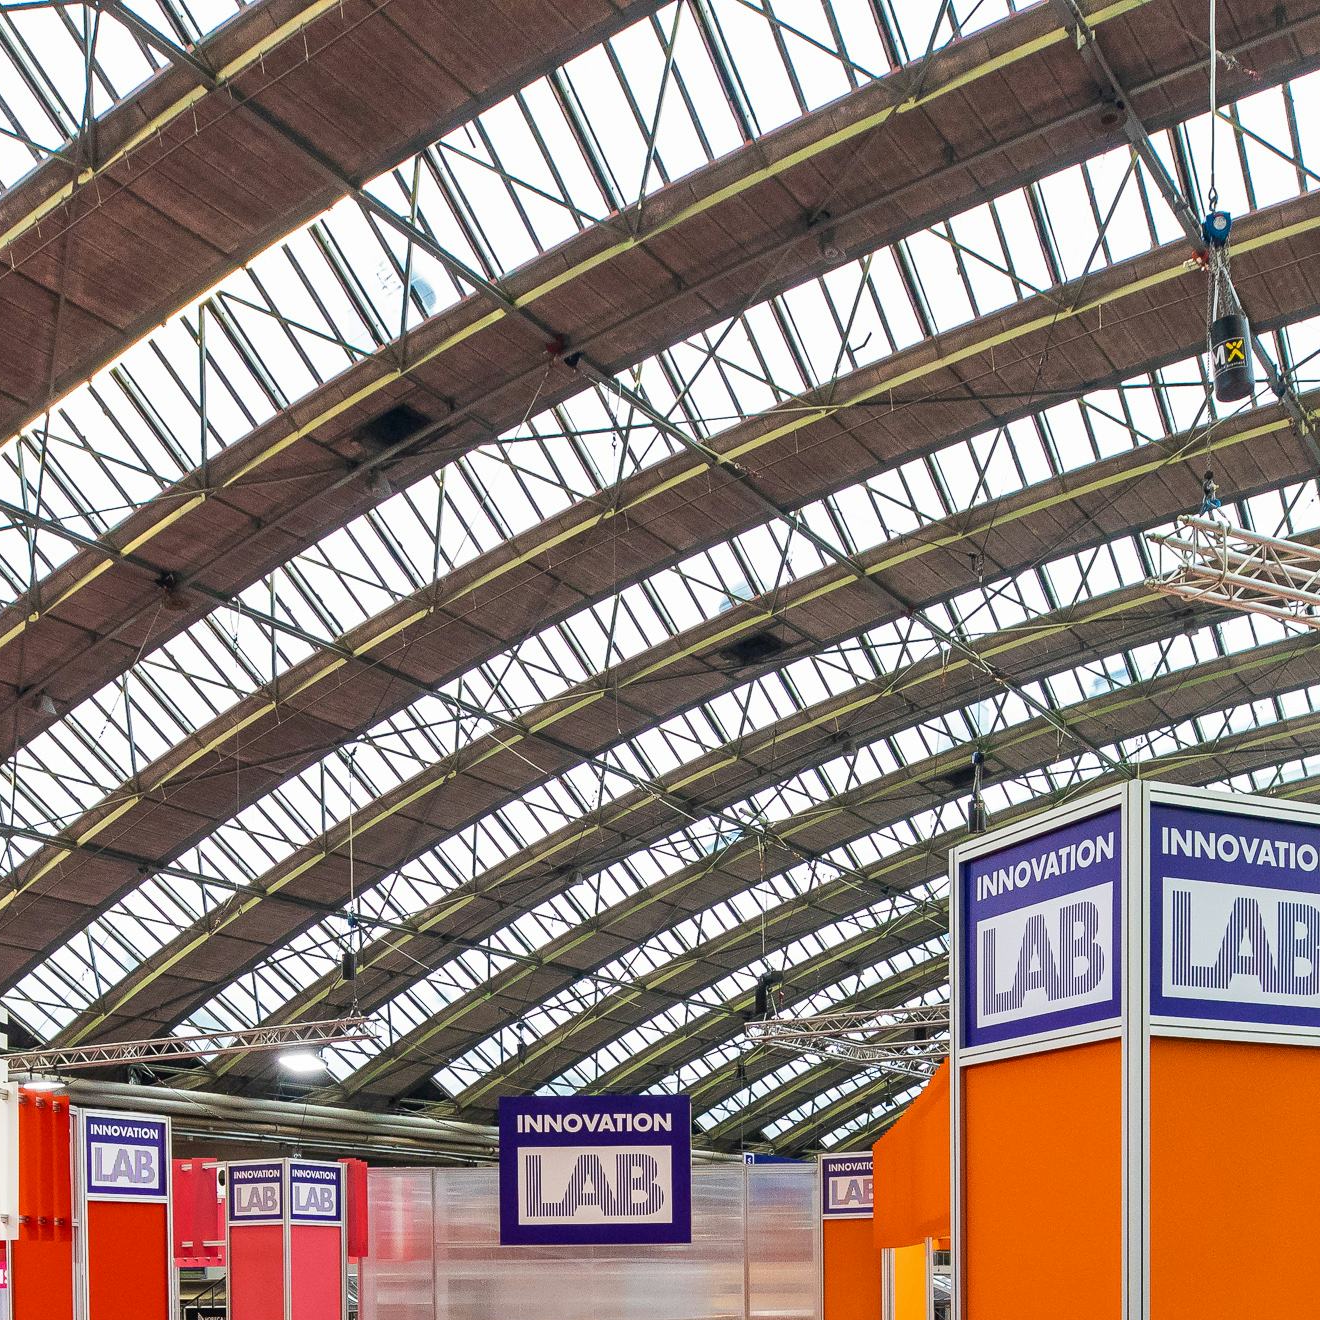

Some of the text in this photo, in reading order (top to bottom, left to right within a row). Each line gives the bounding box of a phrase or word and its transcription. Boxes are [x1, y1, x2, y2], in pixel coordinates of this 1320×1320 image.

[977, 831, 1115, 903] INNOVATION
[982, 899, 1105, 1017] LAB
[90, 1123, 159, 1140] INNOVATION
[516, 1112, 673, 1134] INNOVATION
[94, 1146, 156, 1184] LAB
[233, 1169, 280, 1179] INNOVATION
[292, 1168, 336, 1181] INNOVATION
[294, 1185, 334, 1213] LAB
[525, 1153, 665, 1218] LAB
[236, 1186, 278, 1213] LAB
